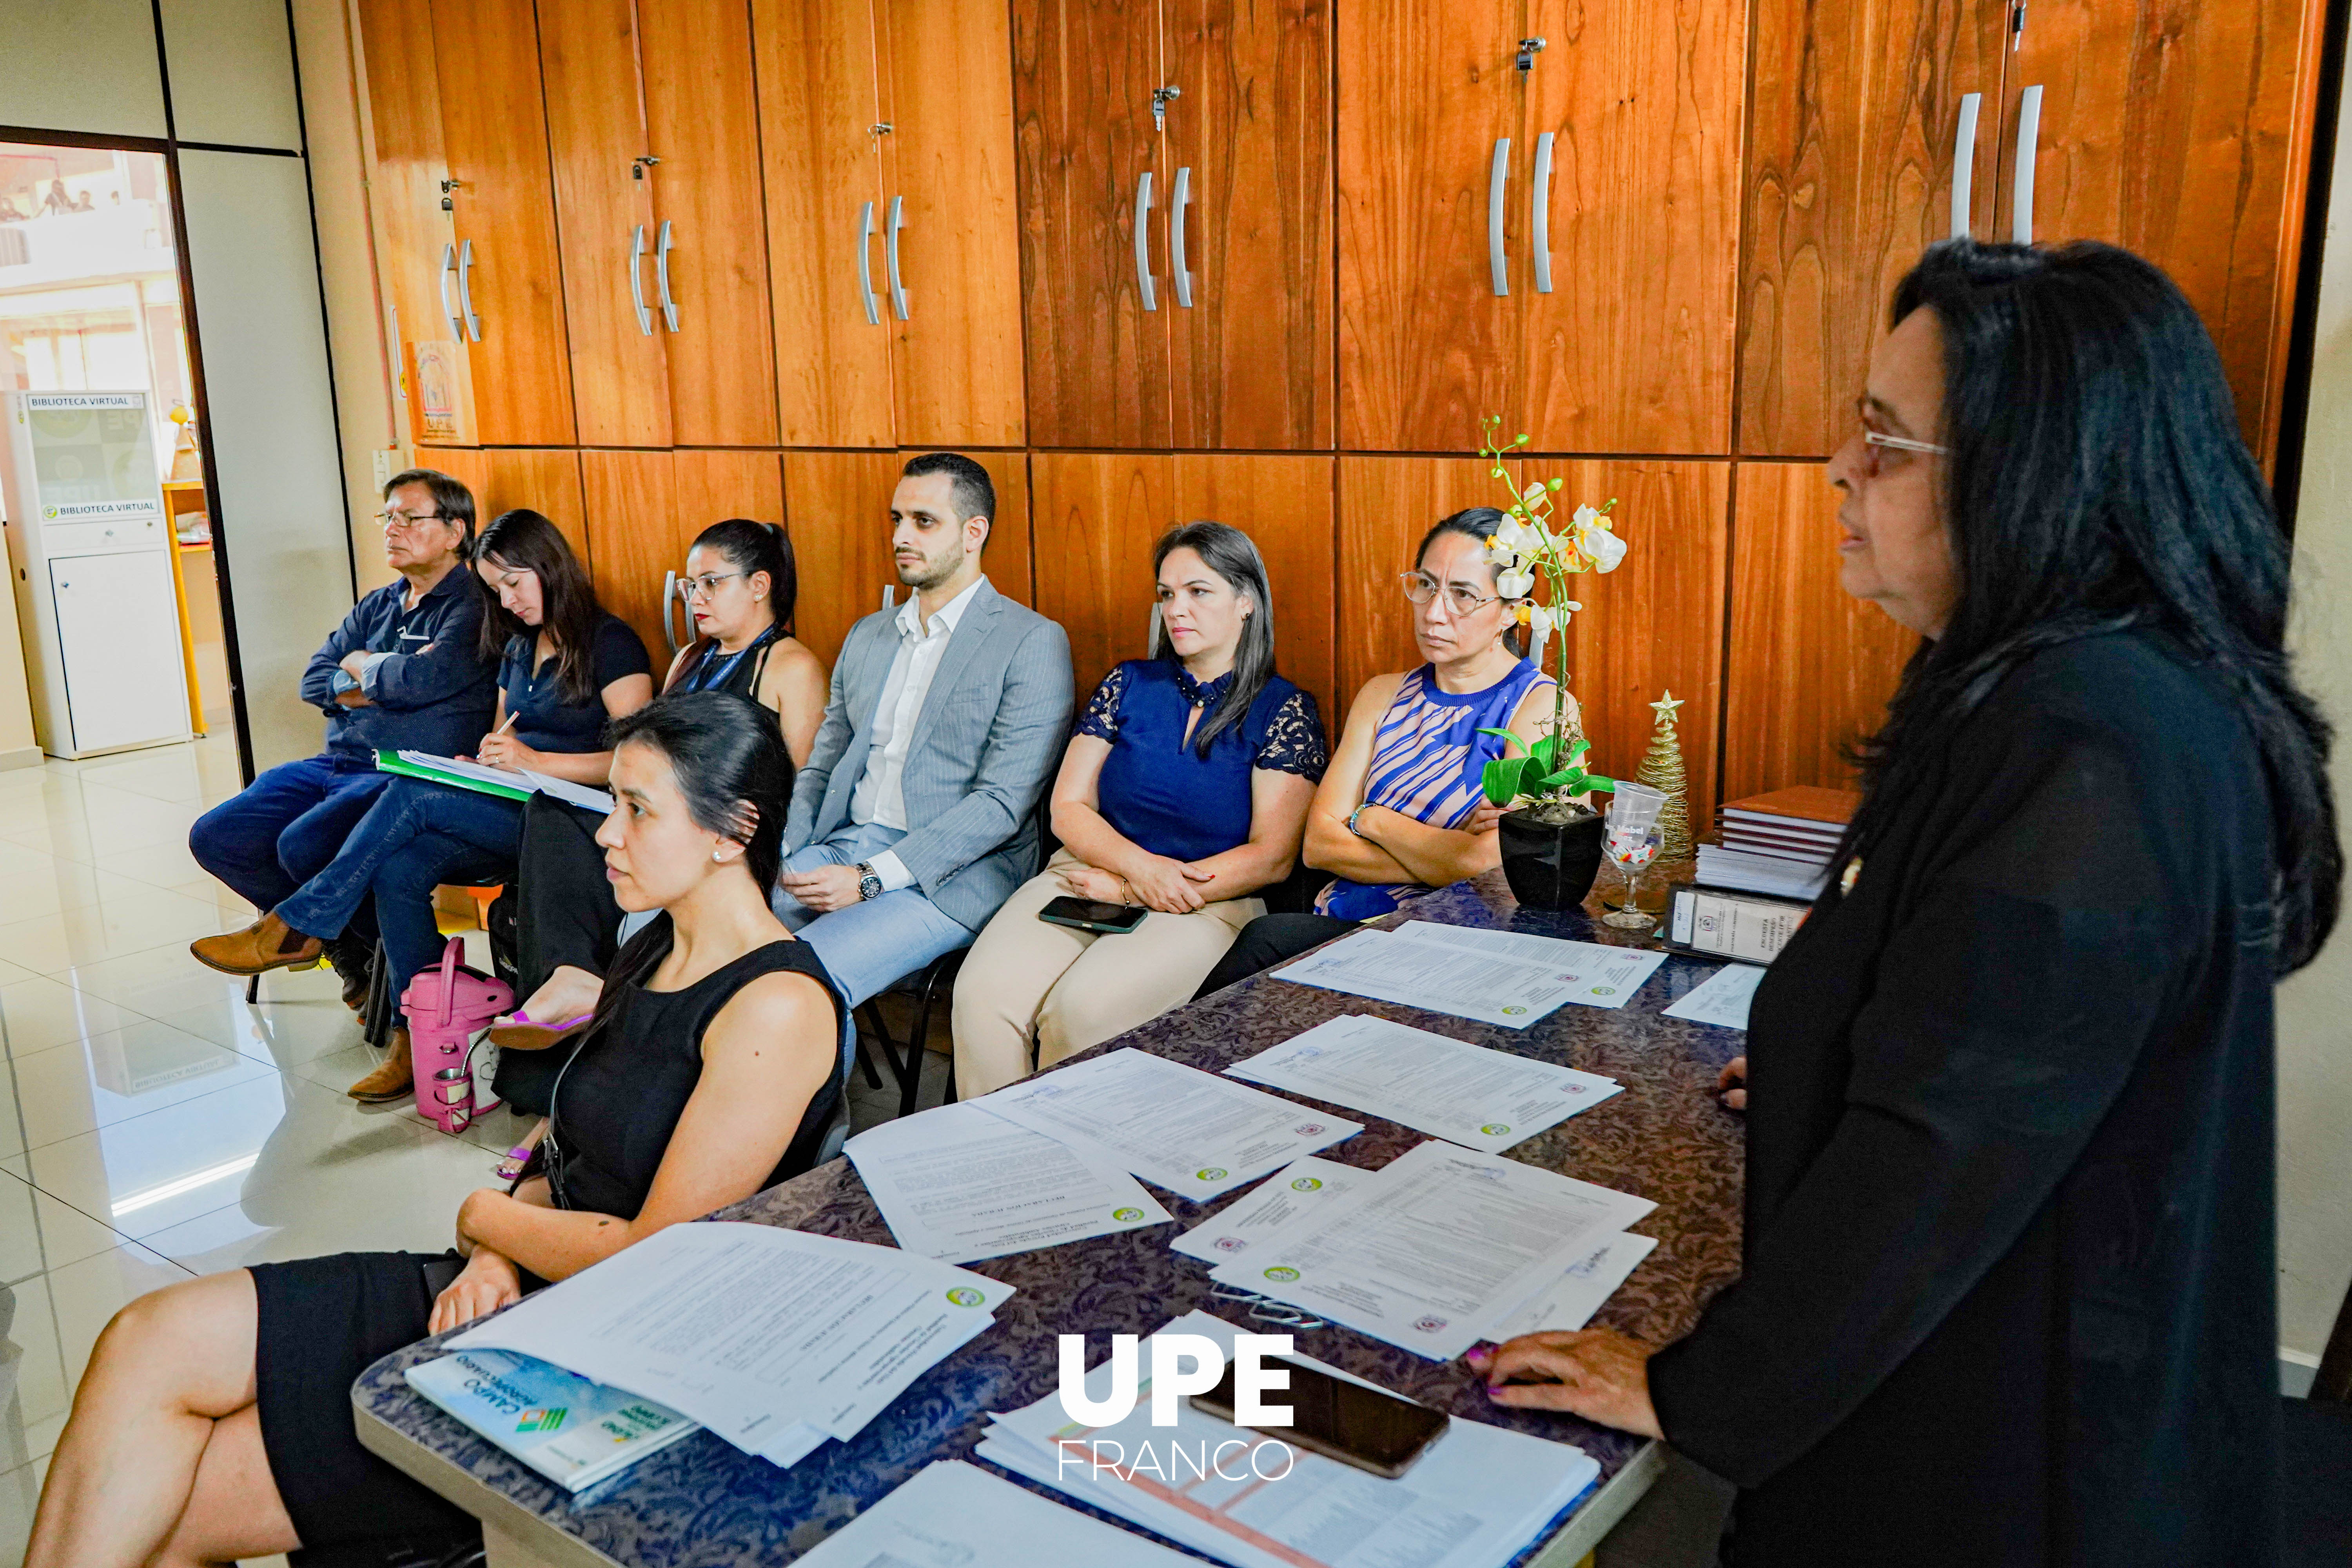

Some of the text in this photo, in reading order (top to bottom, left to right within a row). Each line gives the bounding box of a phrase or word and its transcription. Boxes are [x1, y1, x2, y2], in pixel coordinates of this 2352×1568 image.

[32, 397, 87, 406] BIBLIOTECA
[60, 502, 155, 515] BIBLIOTECA VIRTUAL
[1617, 825, 1644, 835] Mabel
[1760, 919, 1769, 948] ENCUESTA
[463, 1378, 521, 1414] CAMPO
